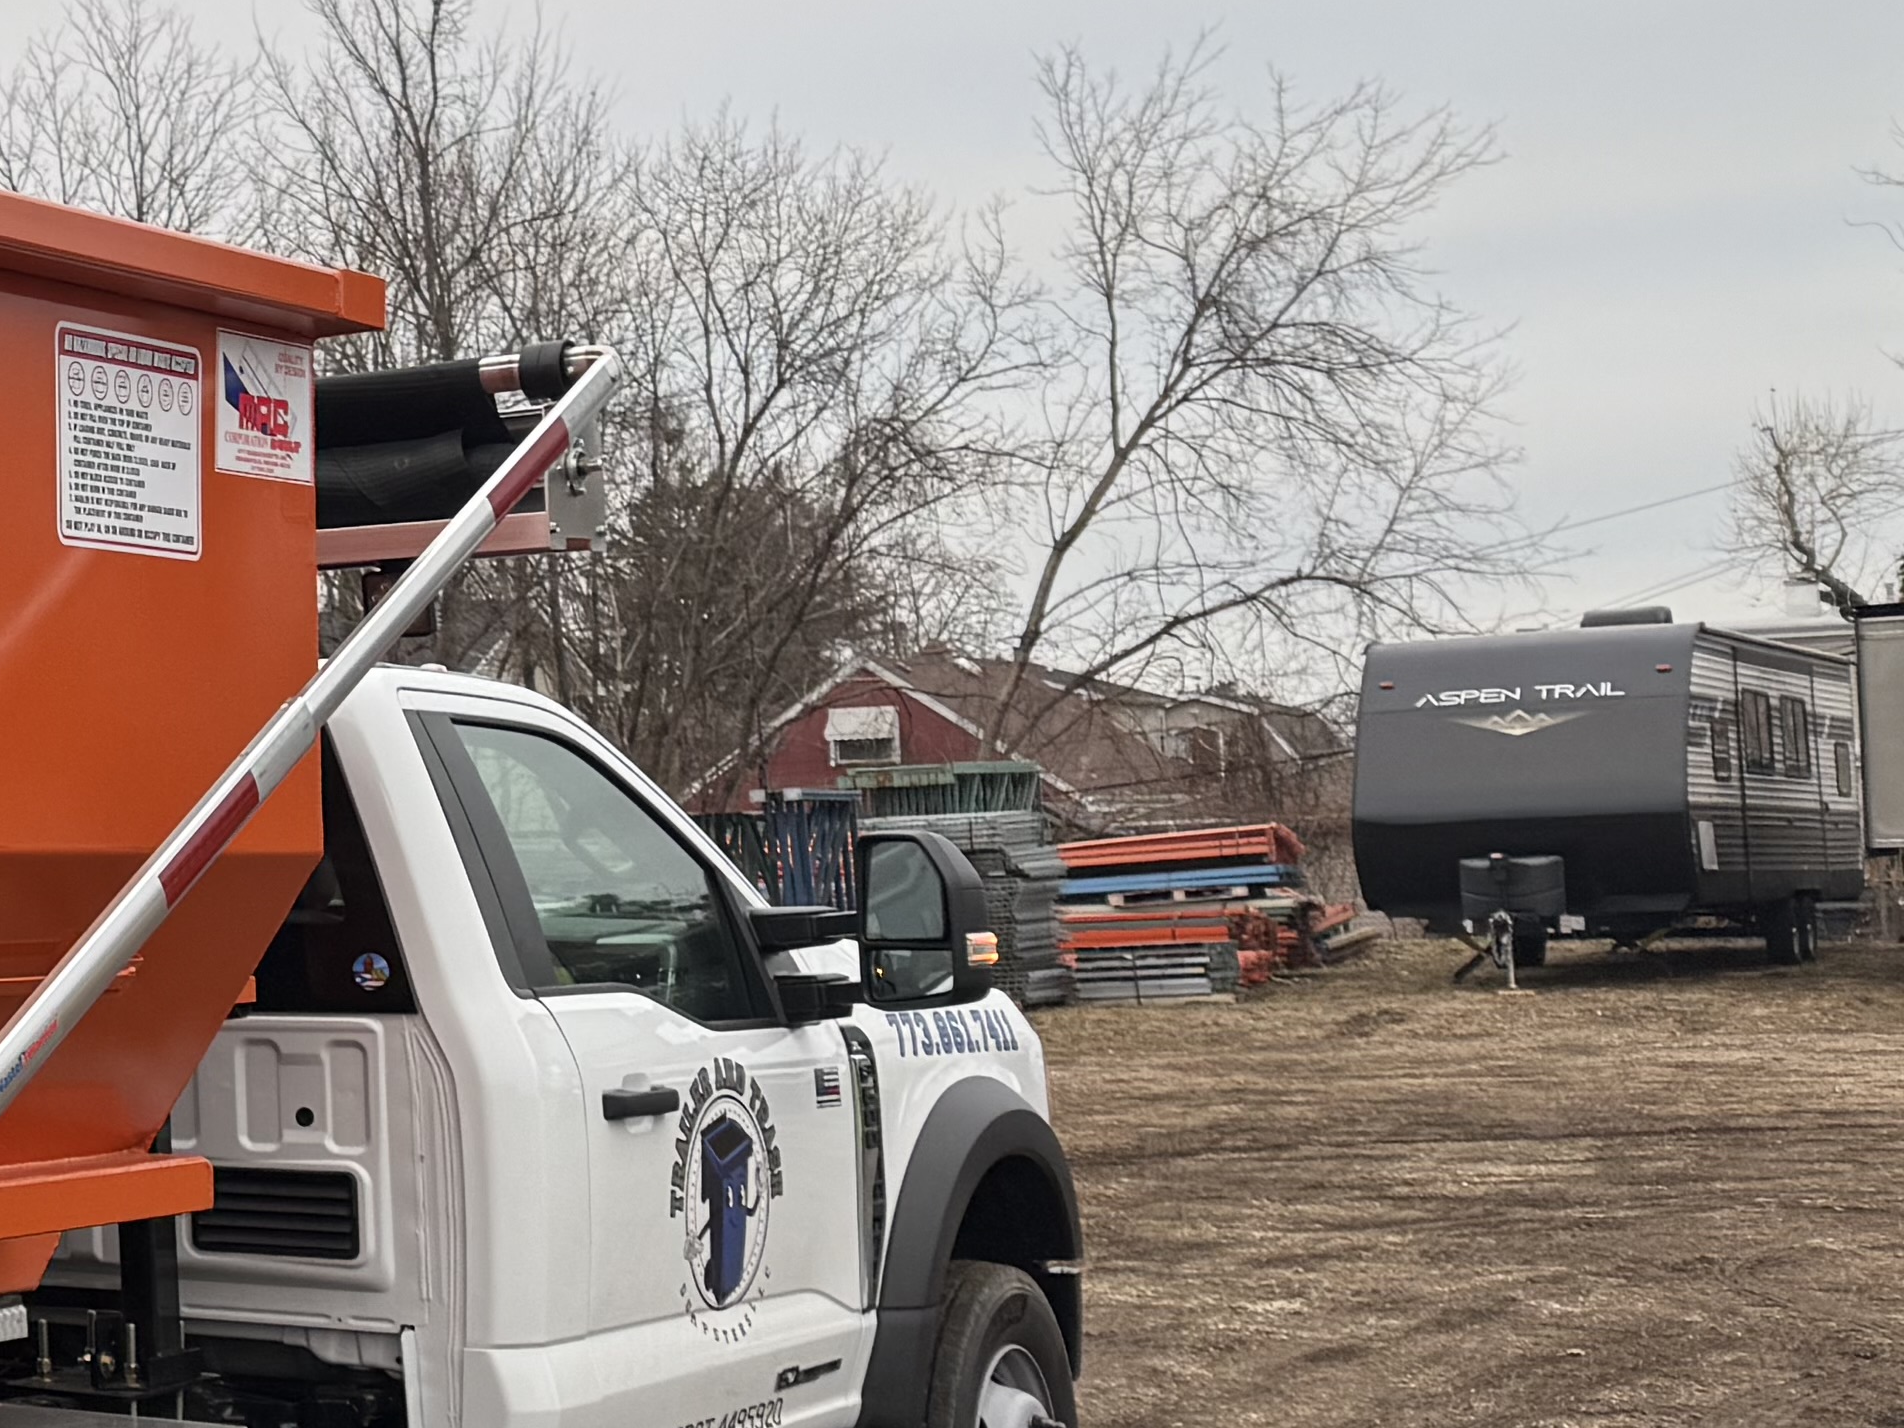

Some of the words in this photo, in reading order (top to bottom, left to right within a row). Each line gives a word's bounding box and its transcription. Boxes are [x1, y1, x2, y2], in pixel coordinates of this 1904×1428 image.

[1413, 686, 1522, 709] ASPEN
[1533, 681, 1626, 701] TRAIL
[884, 1008, 1019, 1058] 773.861.7411
